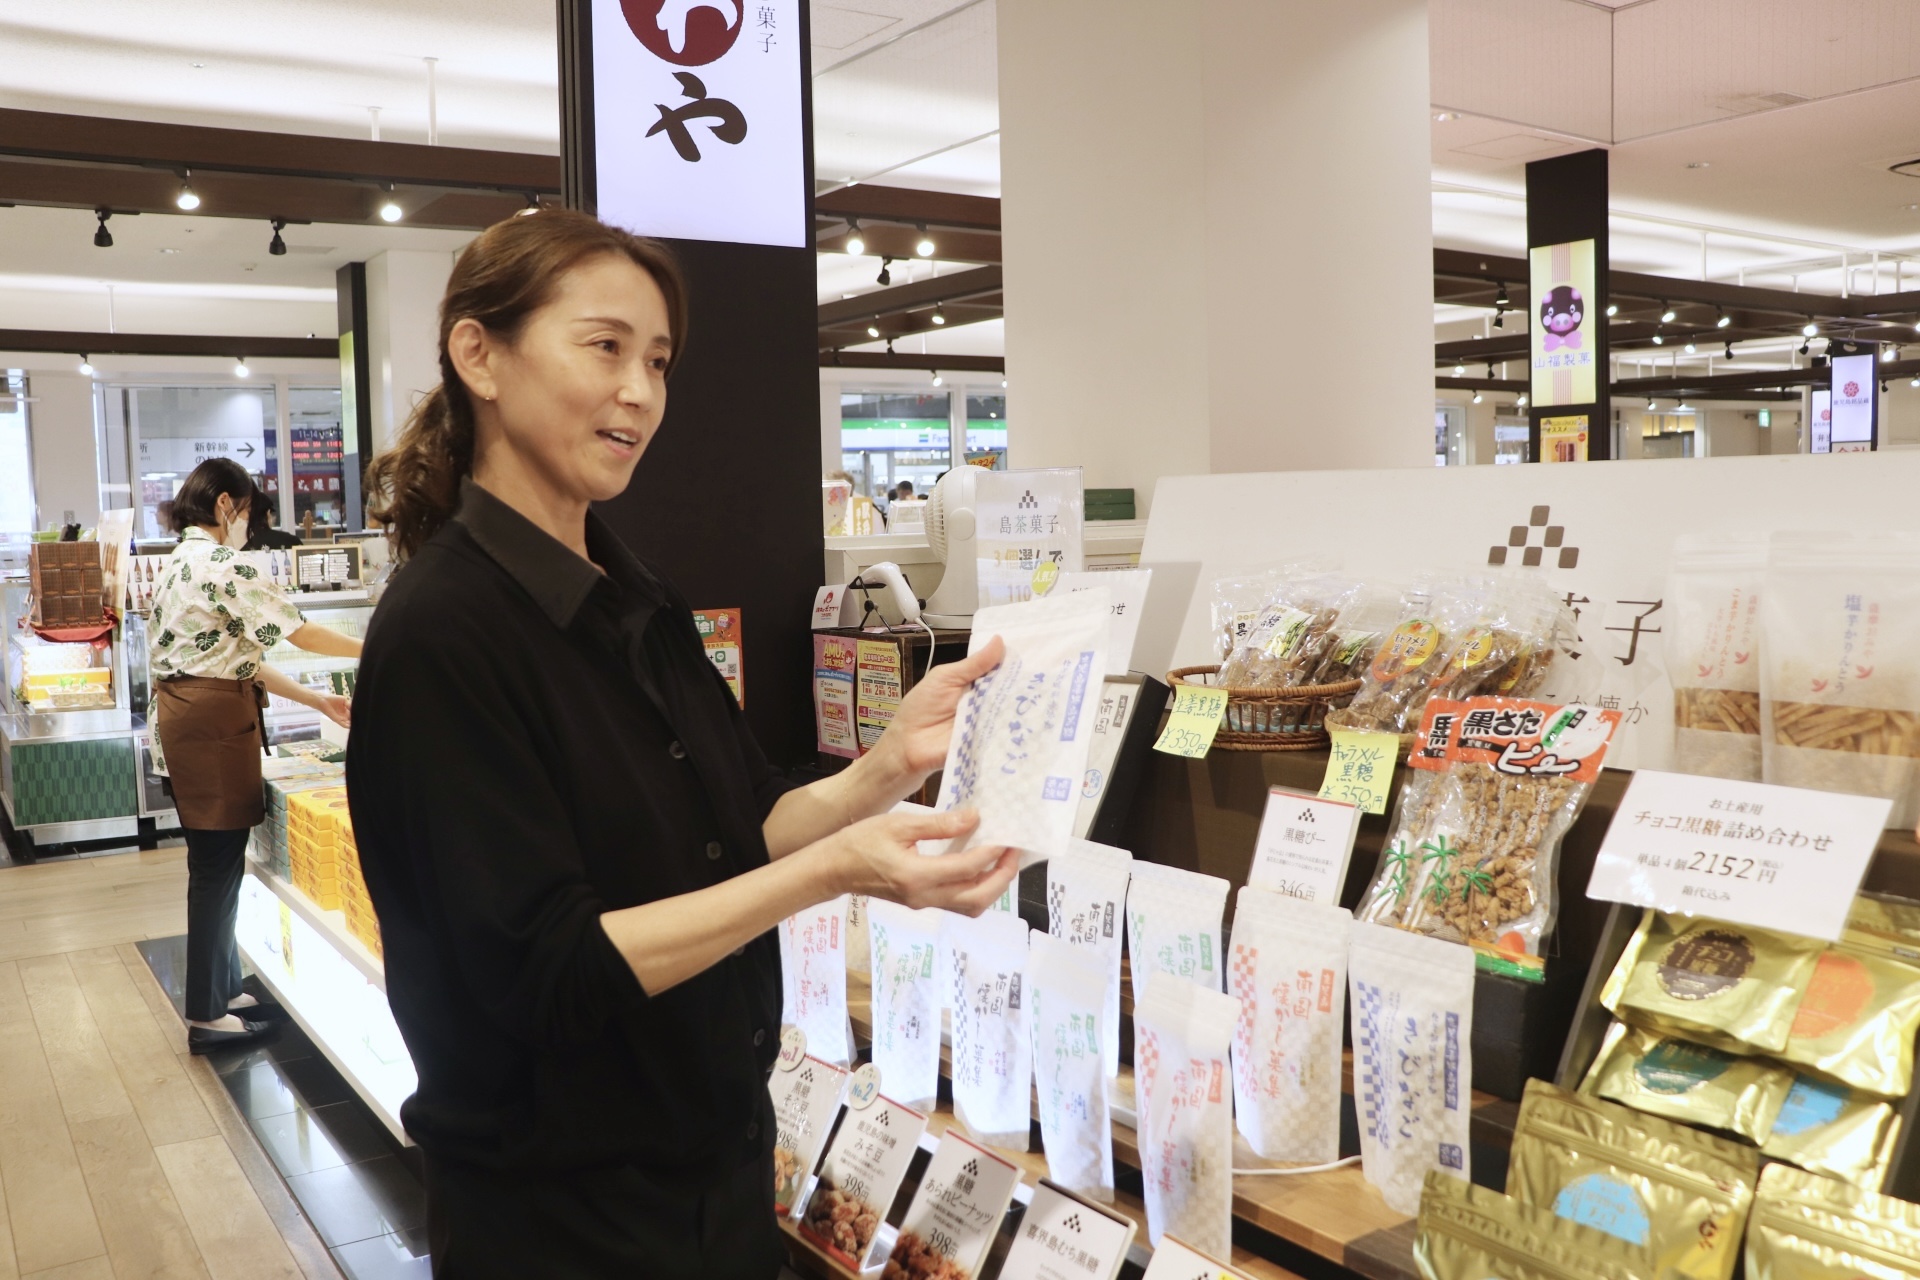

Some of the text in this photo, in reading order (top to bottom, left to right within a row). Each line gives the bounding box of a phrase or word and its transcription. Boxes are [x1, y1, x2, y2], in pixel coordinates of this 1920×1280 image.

[756, 0, 776, 53] 菓子
[1534, 351, 1591, 369] 山福製菓
[194, 442, 229, 453] 新幹線
[999, 514, 1059, 535] 島茶菓子
[1336, 761, 1374, 782] 黒糖
[1709, 798, 1764, 816] お土産用
[1282, 827, 1326, 845] 黒糖びー
[1633, 810, 1834, 853] チョコ黒糖詰め合わせ
[1681, 884, 1731, 902] 箱代込み
[1293, 969, 1313, 1020] 南国
[791, 1080, 812, 1099] 黒糖
[851, 1081, 874, 1102] No.2
[856, 1120, 897, 1150] 鹿児島の味噌
[854, 1137, 885, 1164] みそ豆
[952, 1172, 976, 1196] 黒糖
[925, 1178, 994, 1226] あられピーナッツ
[1026, 1222, 1100, 1274] 喜界島むち黒糖
